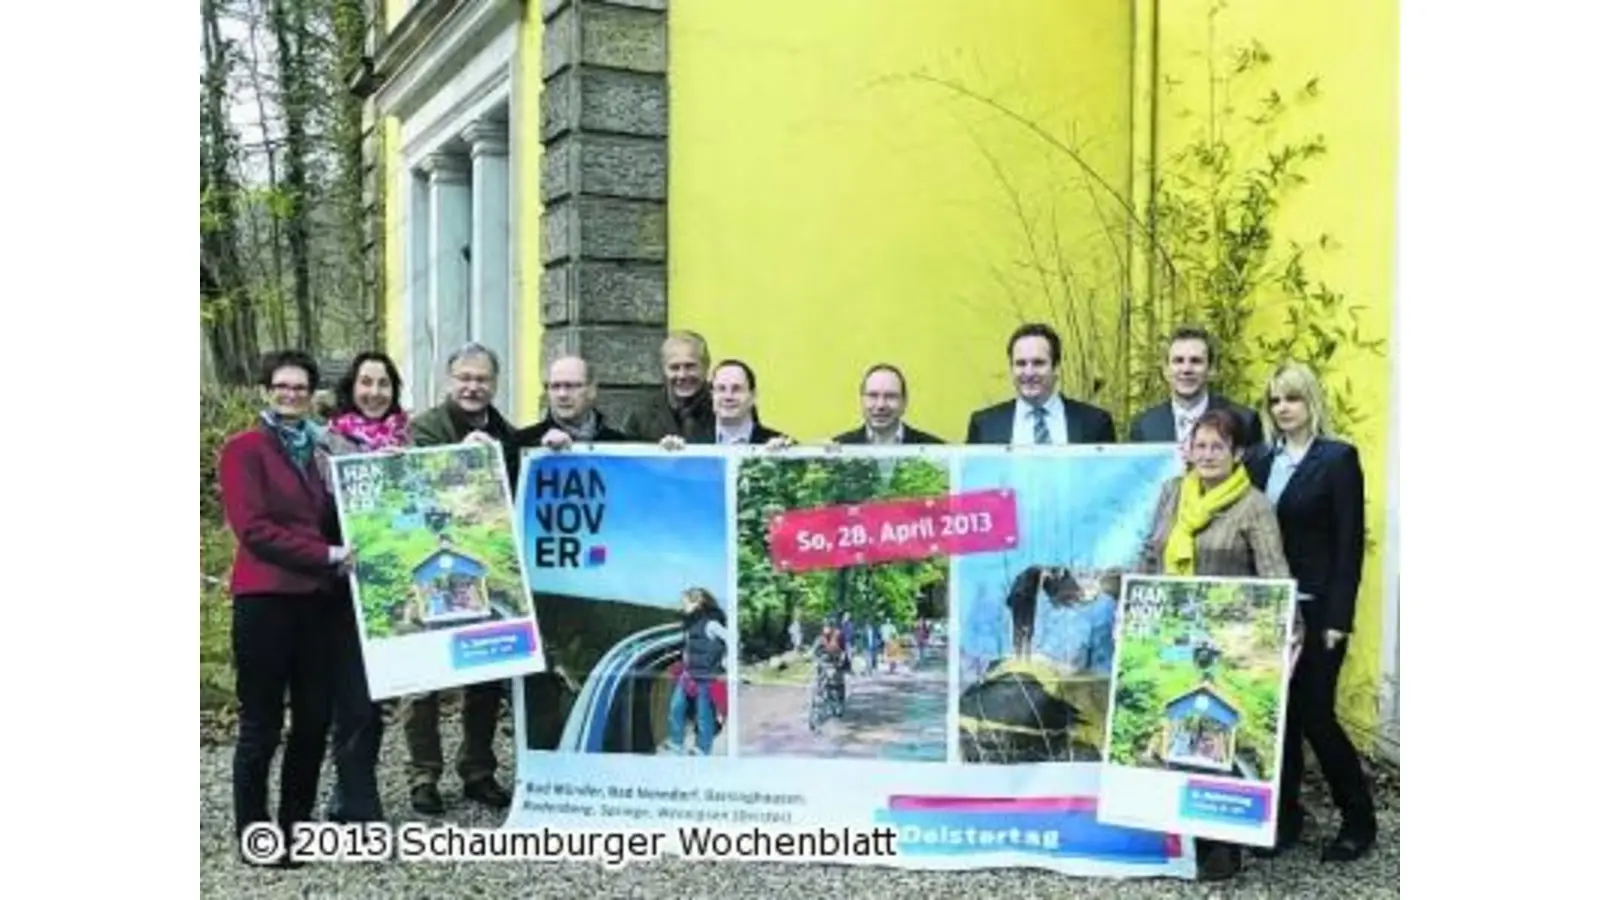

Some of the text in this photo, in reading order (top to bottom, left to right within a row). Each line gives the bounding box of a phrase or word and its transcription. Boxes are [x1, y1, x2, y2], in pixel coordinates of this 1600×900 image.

[535, 467, 606, 499] HAN
[535, 502, 605, 534] NOV
[796, 511, 993, 552] So, 28. April 2013
[535, 536, 581, 568] ER
